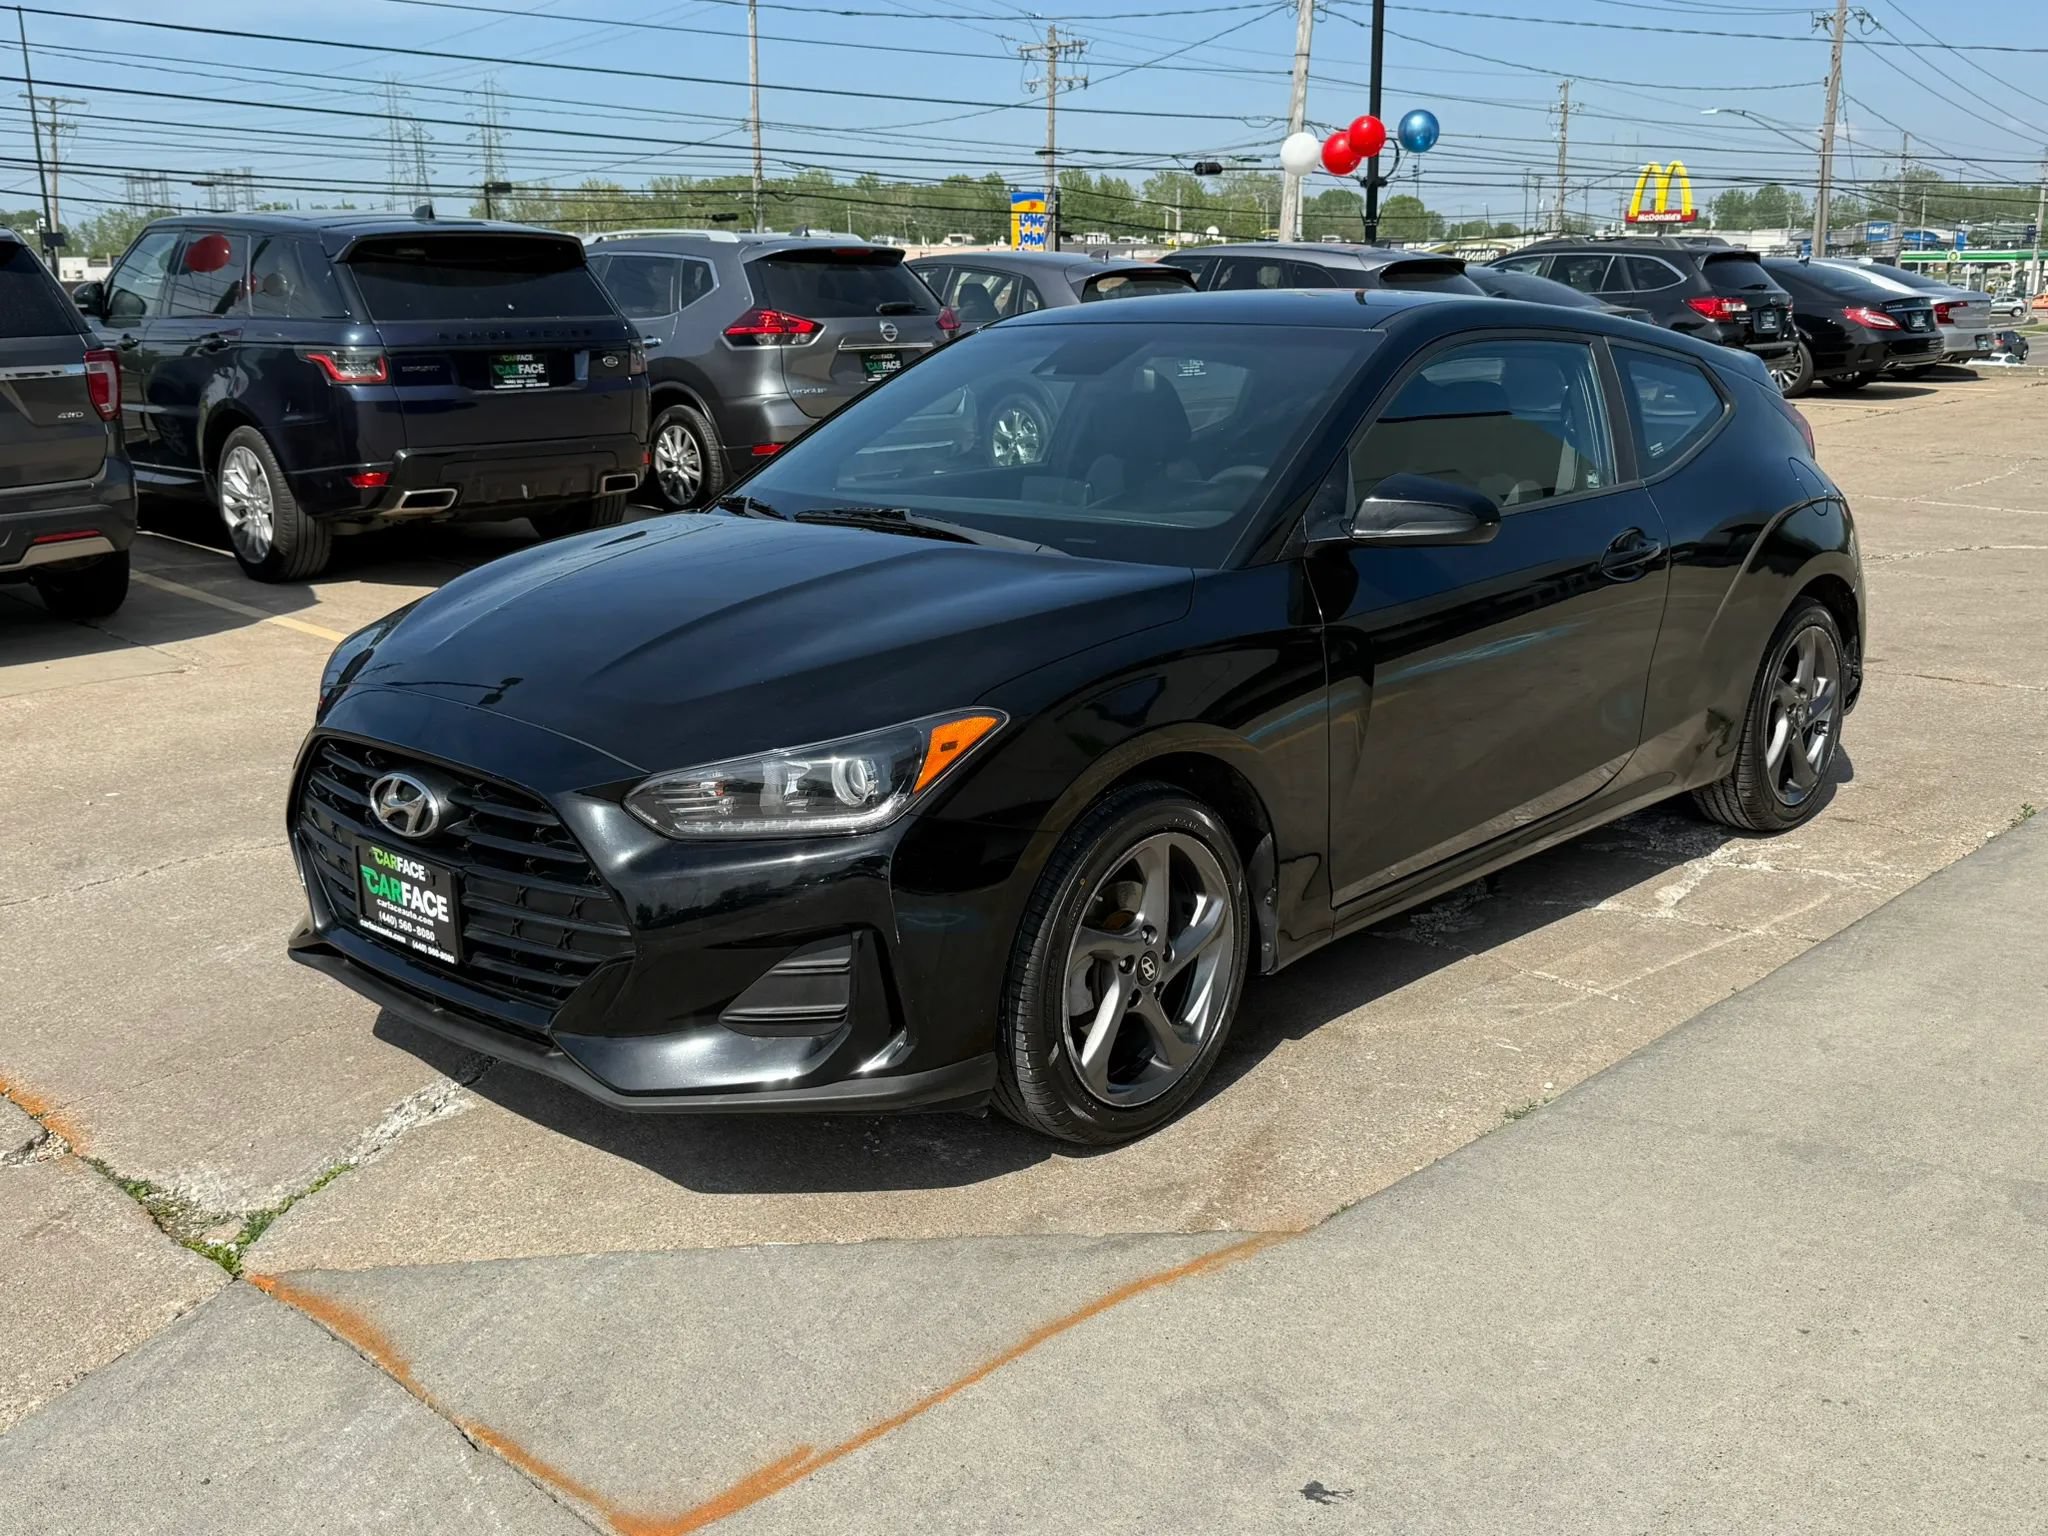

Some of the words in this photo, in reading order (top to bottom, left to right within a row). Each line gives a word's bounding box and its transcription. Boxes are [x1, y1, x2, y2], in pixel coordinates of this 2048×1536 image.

[1019, 213, 1045, 227] LONG
[1637, 212, 1682, 222] McDonald's
[494, 362, 545, 375] CARFACE
[370, 846, 426, 882] CARFACE
[360, 864, 450, 923] CARFACE
[376, 898, 434, 927] carfaceauto.com
[378, 910, 398, 929] (440)
